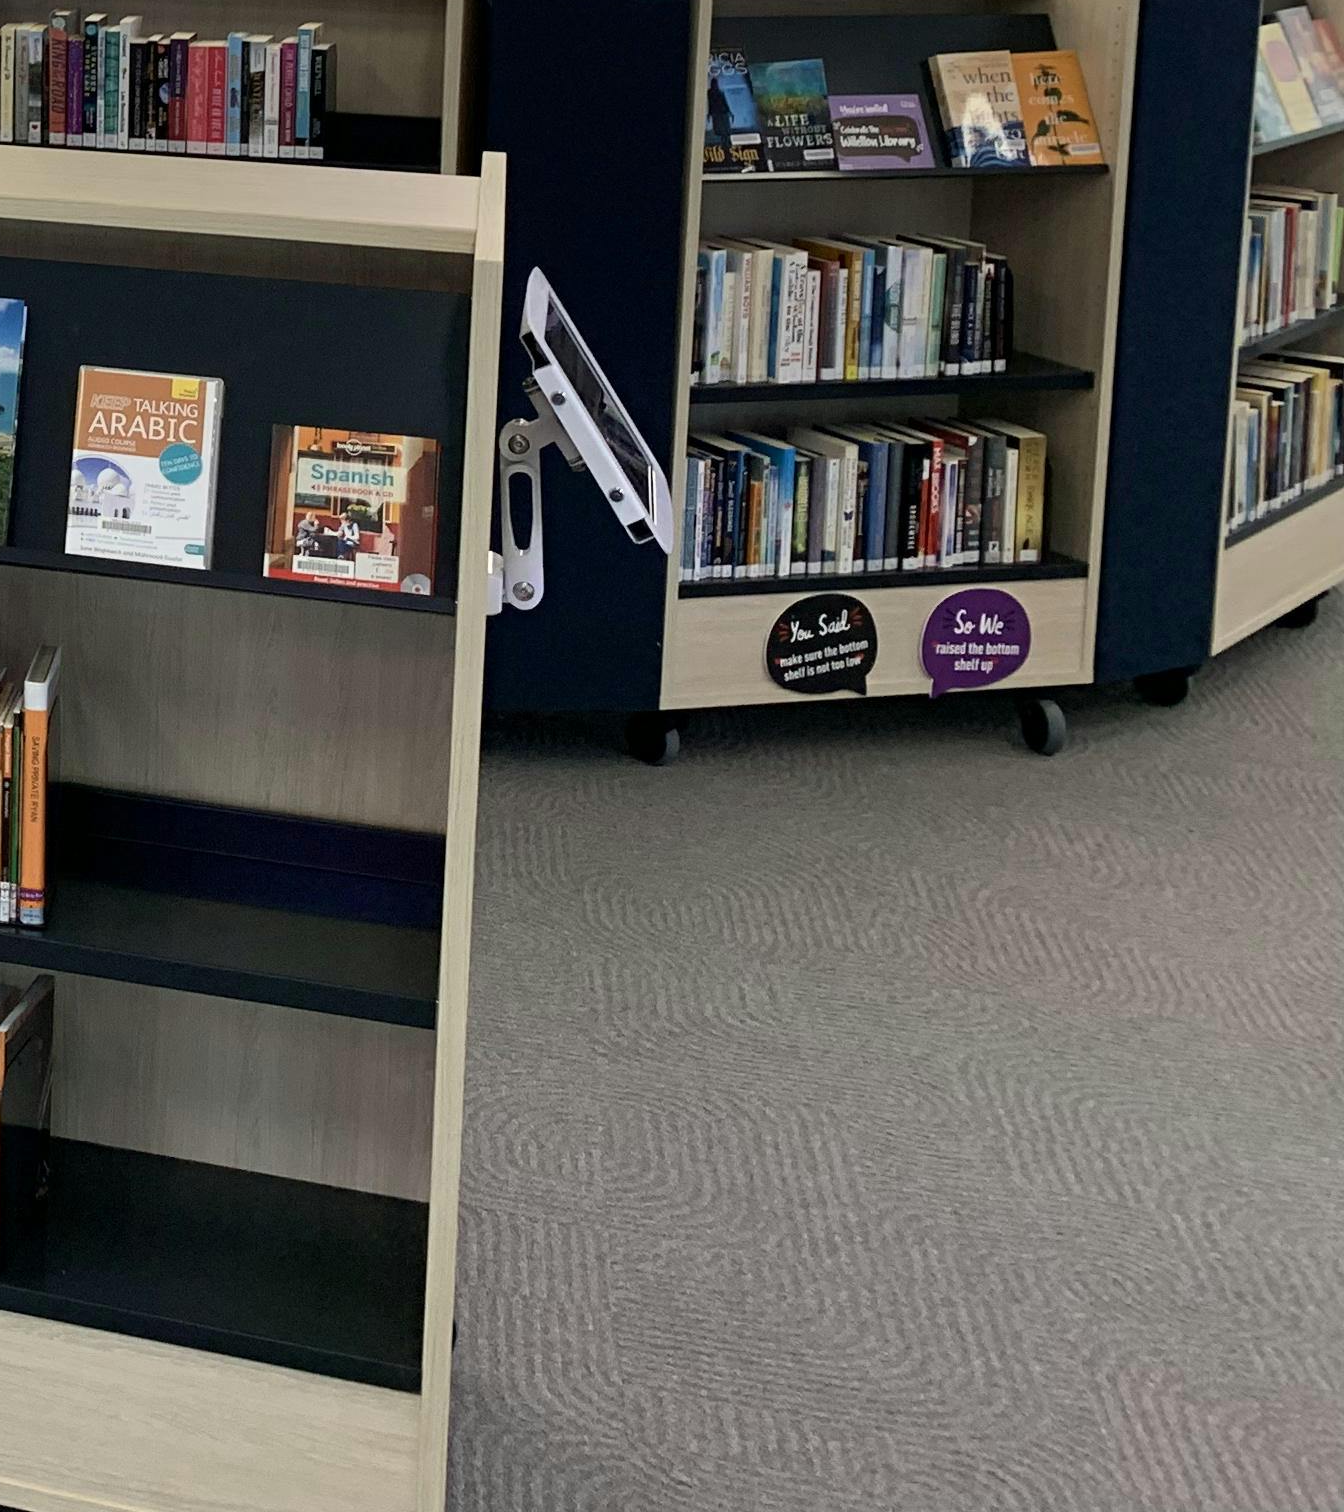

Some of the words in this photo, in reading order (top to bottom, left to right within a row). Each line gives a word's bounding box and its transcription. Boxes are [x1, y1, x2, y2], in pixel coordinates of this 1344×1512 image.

[963, 67, 1011, 85] when
[986, 88, 1014, 103] the
[775, 113, 809, 127] LIFE
[782, 125, 826, 134] WITHOUT
[767, 132, 833, 149] FLOWERS
[731, 146, 759, 165] Sign
[133, 398, 199, 418] TALKING
[88, 411, 198, 444] ARABIC
[933, 447, 942, 471] MAX
[311, 463, 394, 487] Spanish
[322, 485, 374, 497] PHRASEBOOK
[931, 473, 941, 514] BROOKS
[790, 619, 815, 643] You
[818, 609, 852, 637] Said
[954, 609, 975, 634] So
[980, 613, 1004, 635] We
[804, 650, 823, 663] sure
[824, 646, 838, 659] the
[838, 639, 869, 656] bottom
[967, 643, 983, 656] the
[985, 643, 1020, 656] bottom
[783, 666, 806, 682] shelf
[807, 665, 815, 676] is
[816, 662, 830, 674] not
[831, 659, 845, 670] too
[954, 659, 979, 671] shelf
[31, 736, 40, 763] SAVING
[30, 765, 40, 800] PRIVATE
[29, 802, 39, 823] RYAN
